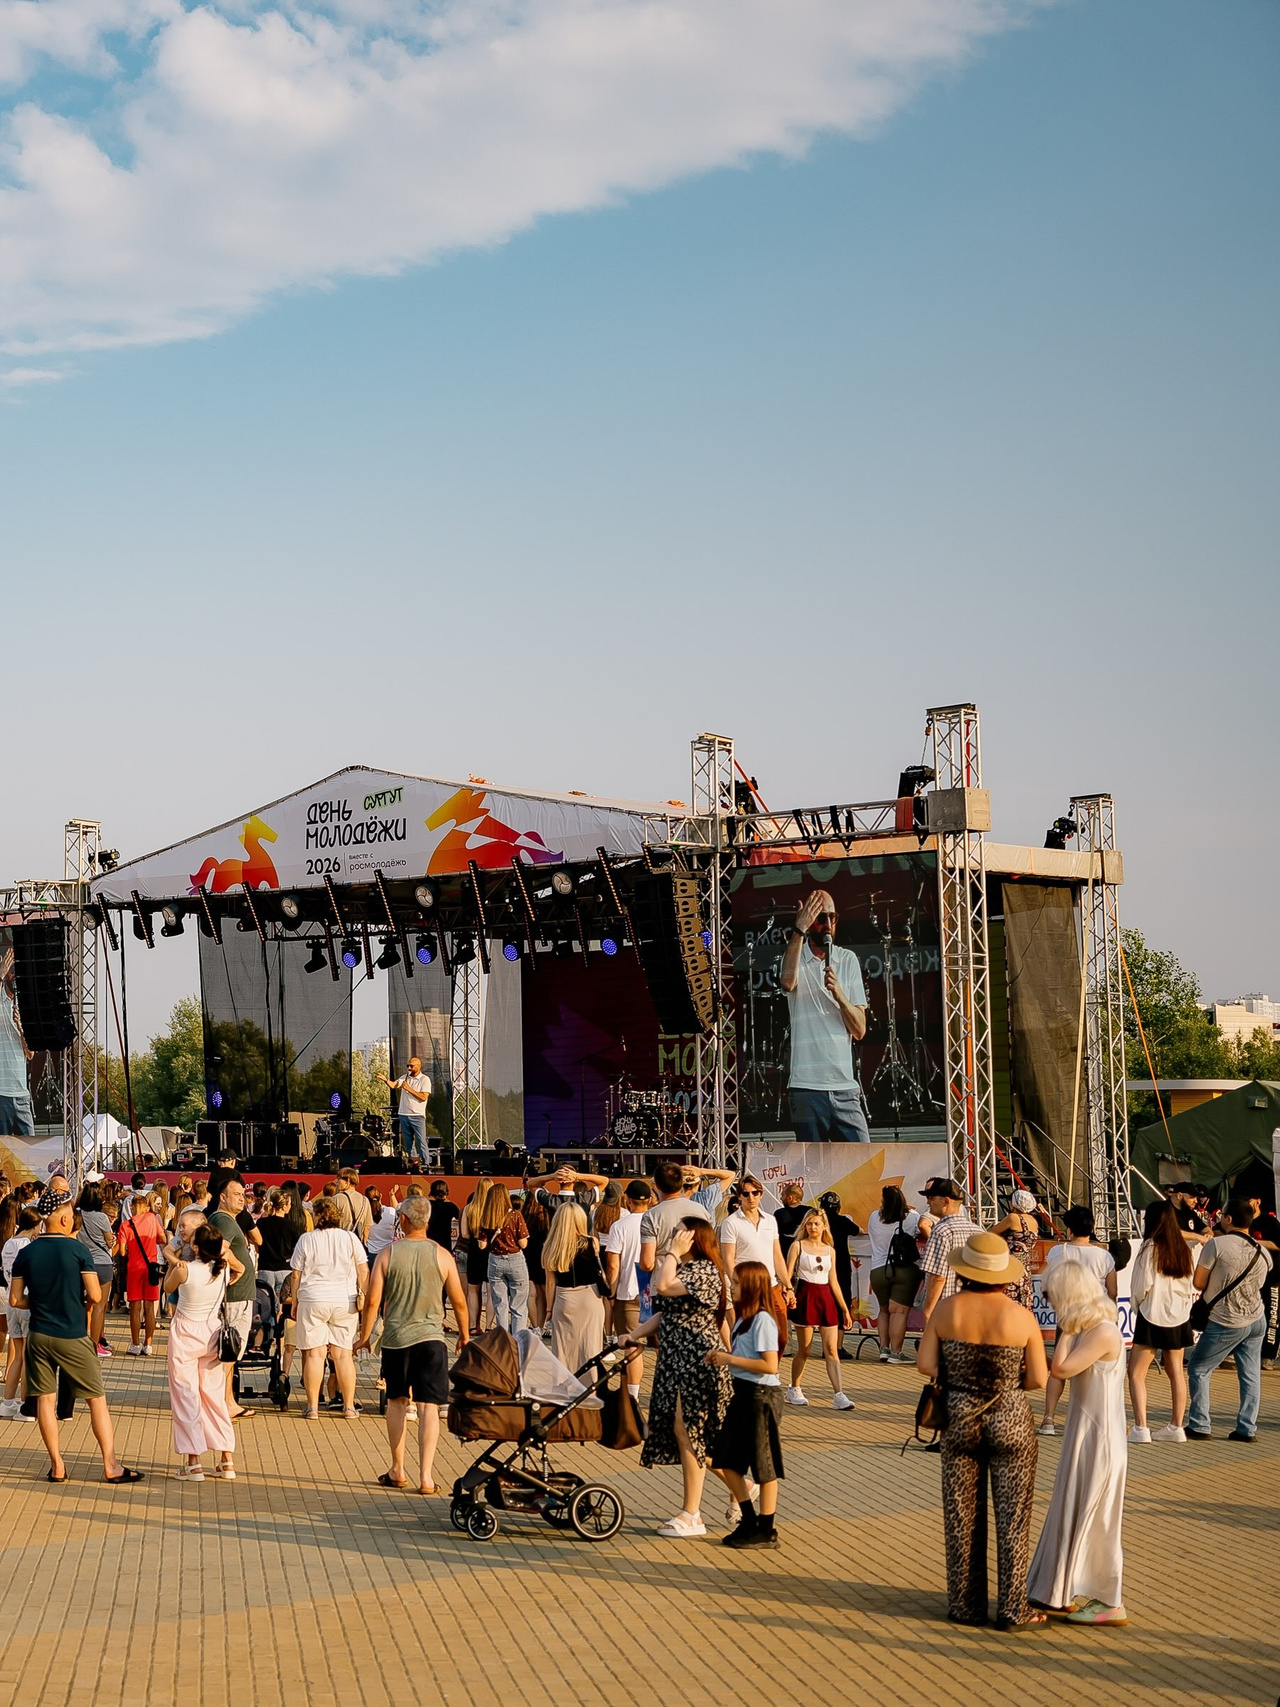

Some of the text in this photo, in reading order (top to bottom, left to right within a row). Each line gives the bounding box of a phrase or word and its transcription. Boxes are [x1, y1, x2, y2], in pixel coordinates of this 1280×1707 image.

[364, 787, 404, 810] СУРГУТ
[306, 799, 353, 825] ДЕНЬ
[305, 816, 407, 850] МОЛОДЁЖИ
[305, 857, 341, 876] 2026
[349, 859, 407, 873] росмолодёжь
[762, 1164, 787, 1180] ГОРИ
